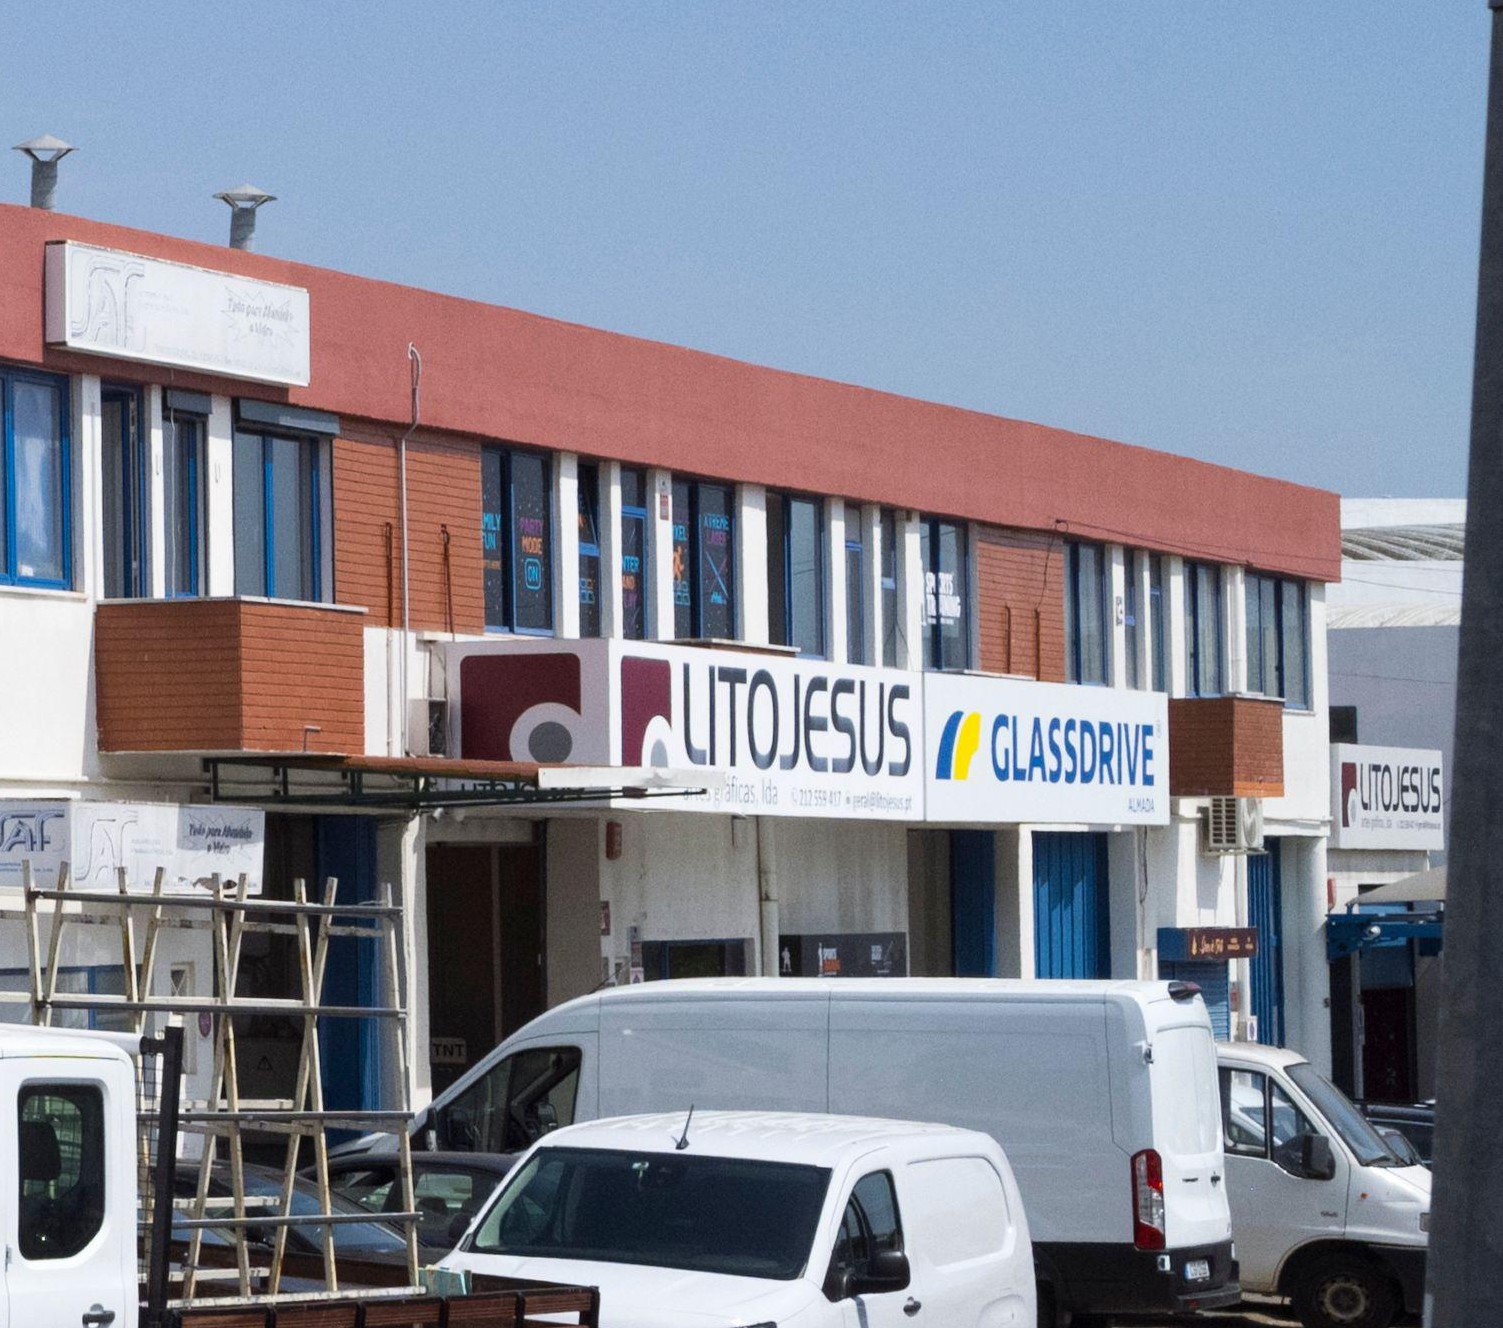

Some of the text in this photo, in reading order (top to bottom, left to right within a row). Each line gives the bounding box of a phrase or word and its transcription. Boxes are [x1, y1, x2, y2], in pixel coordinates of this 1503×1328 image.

[520, 517, 543, 535] PARTY
[673, 524, 687, 542] XEL
[522, 535, 543, 555] MODE
[622, 555, 639, 573] NTER
[528, 565, 539, 582] ON
[683, 662, 911, 777] LITOJESUS
[991, 714, 1154, 786] GLASSDRIVE
[762, 777, 778, 805] lda
[1360, 764, 1441, 813] LITOJESUS
[1128, 798, 1155, 812] ALMADA
[432, 1043, 465, 1058] TNT
